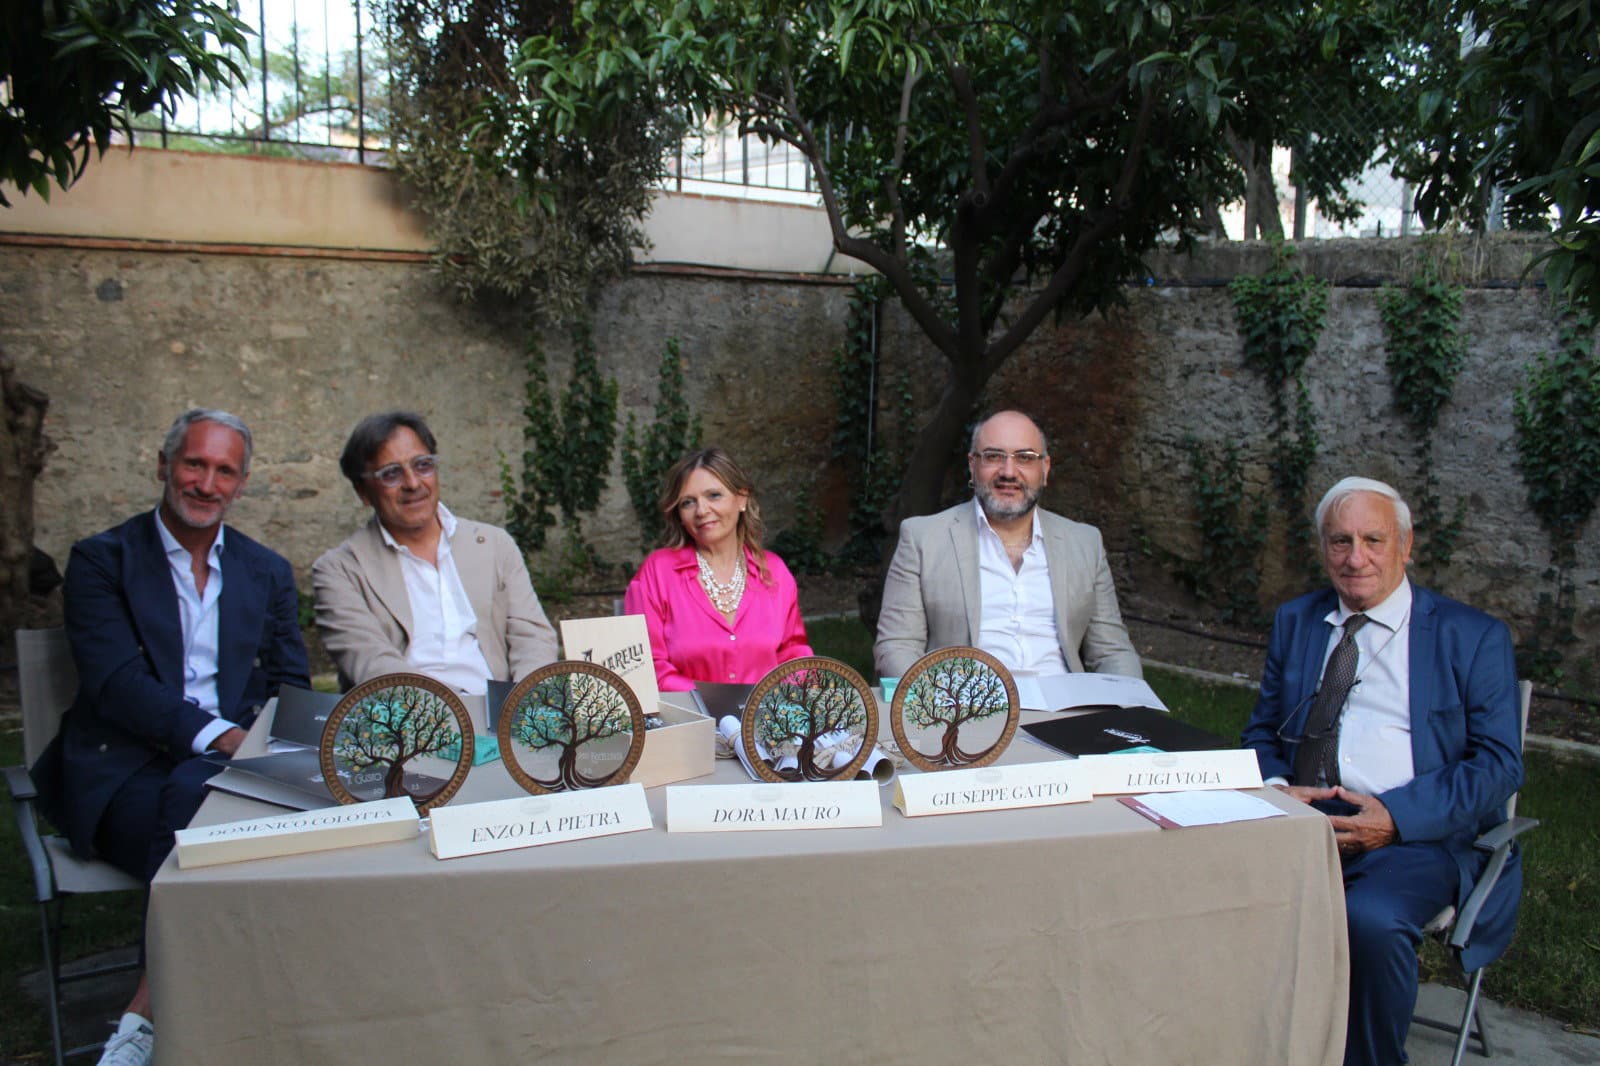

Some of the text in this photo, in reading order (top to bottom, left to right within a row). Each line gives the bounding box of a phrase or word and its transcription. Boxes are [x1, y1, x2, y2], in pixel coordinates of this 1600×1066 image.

[1127, 771, 1222, 786] LUIGI VIOLA
[932, 782, 1069, 806] GIUSEPPE GATTO
[208, 810, 393, 837] DOMENICO COLOTTA
[713, 806, 841, 823] DORA MAURO
[471, 811, 621, 843] ENZO LA PIETRA
